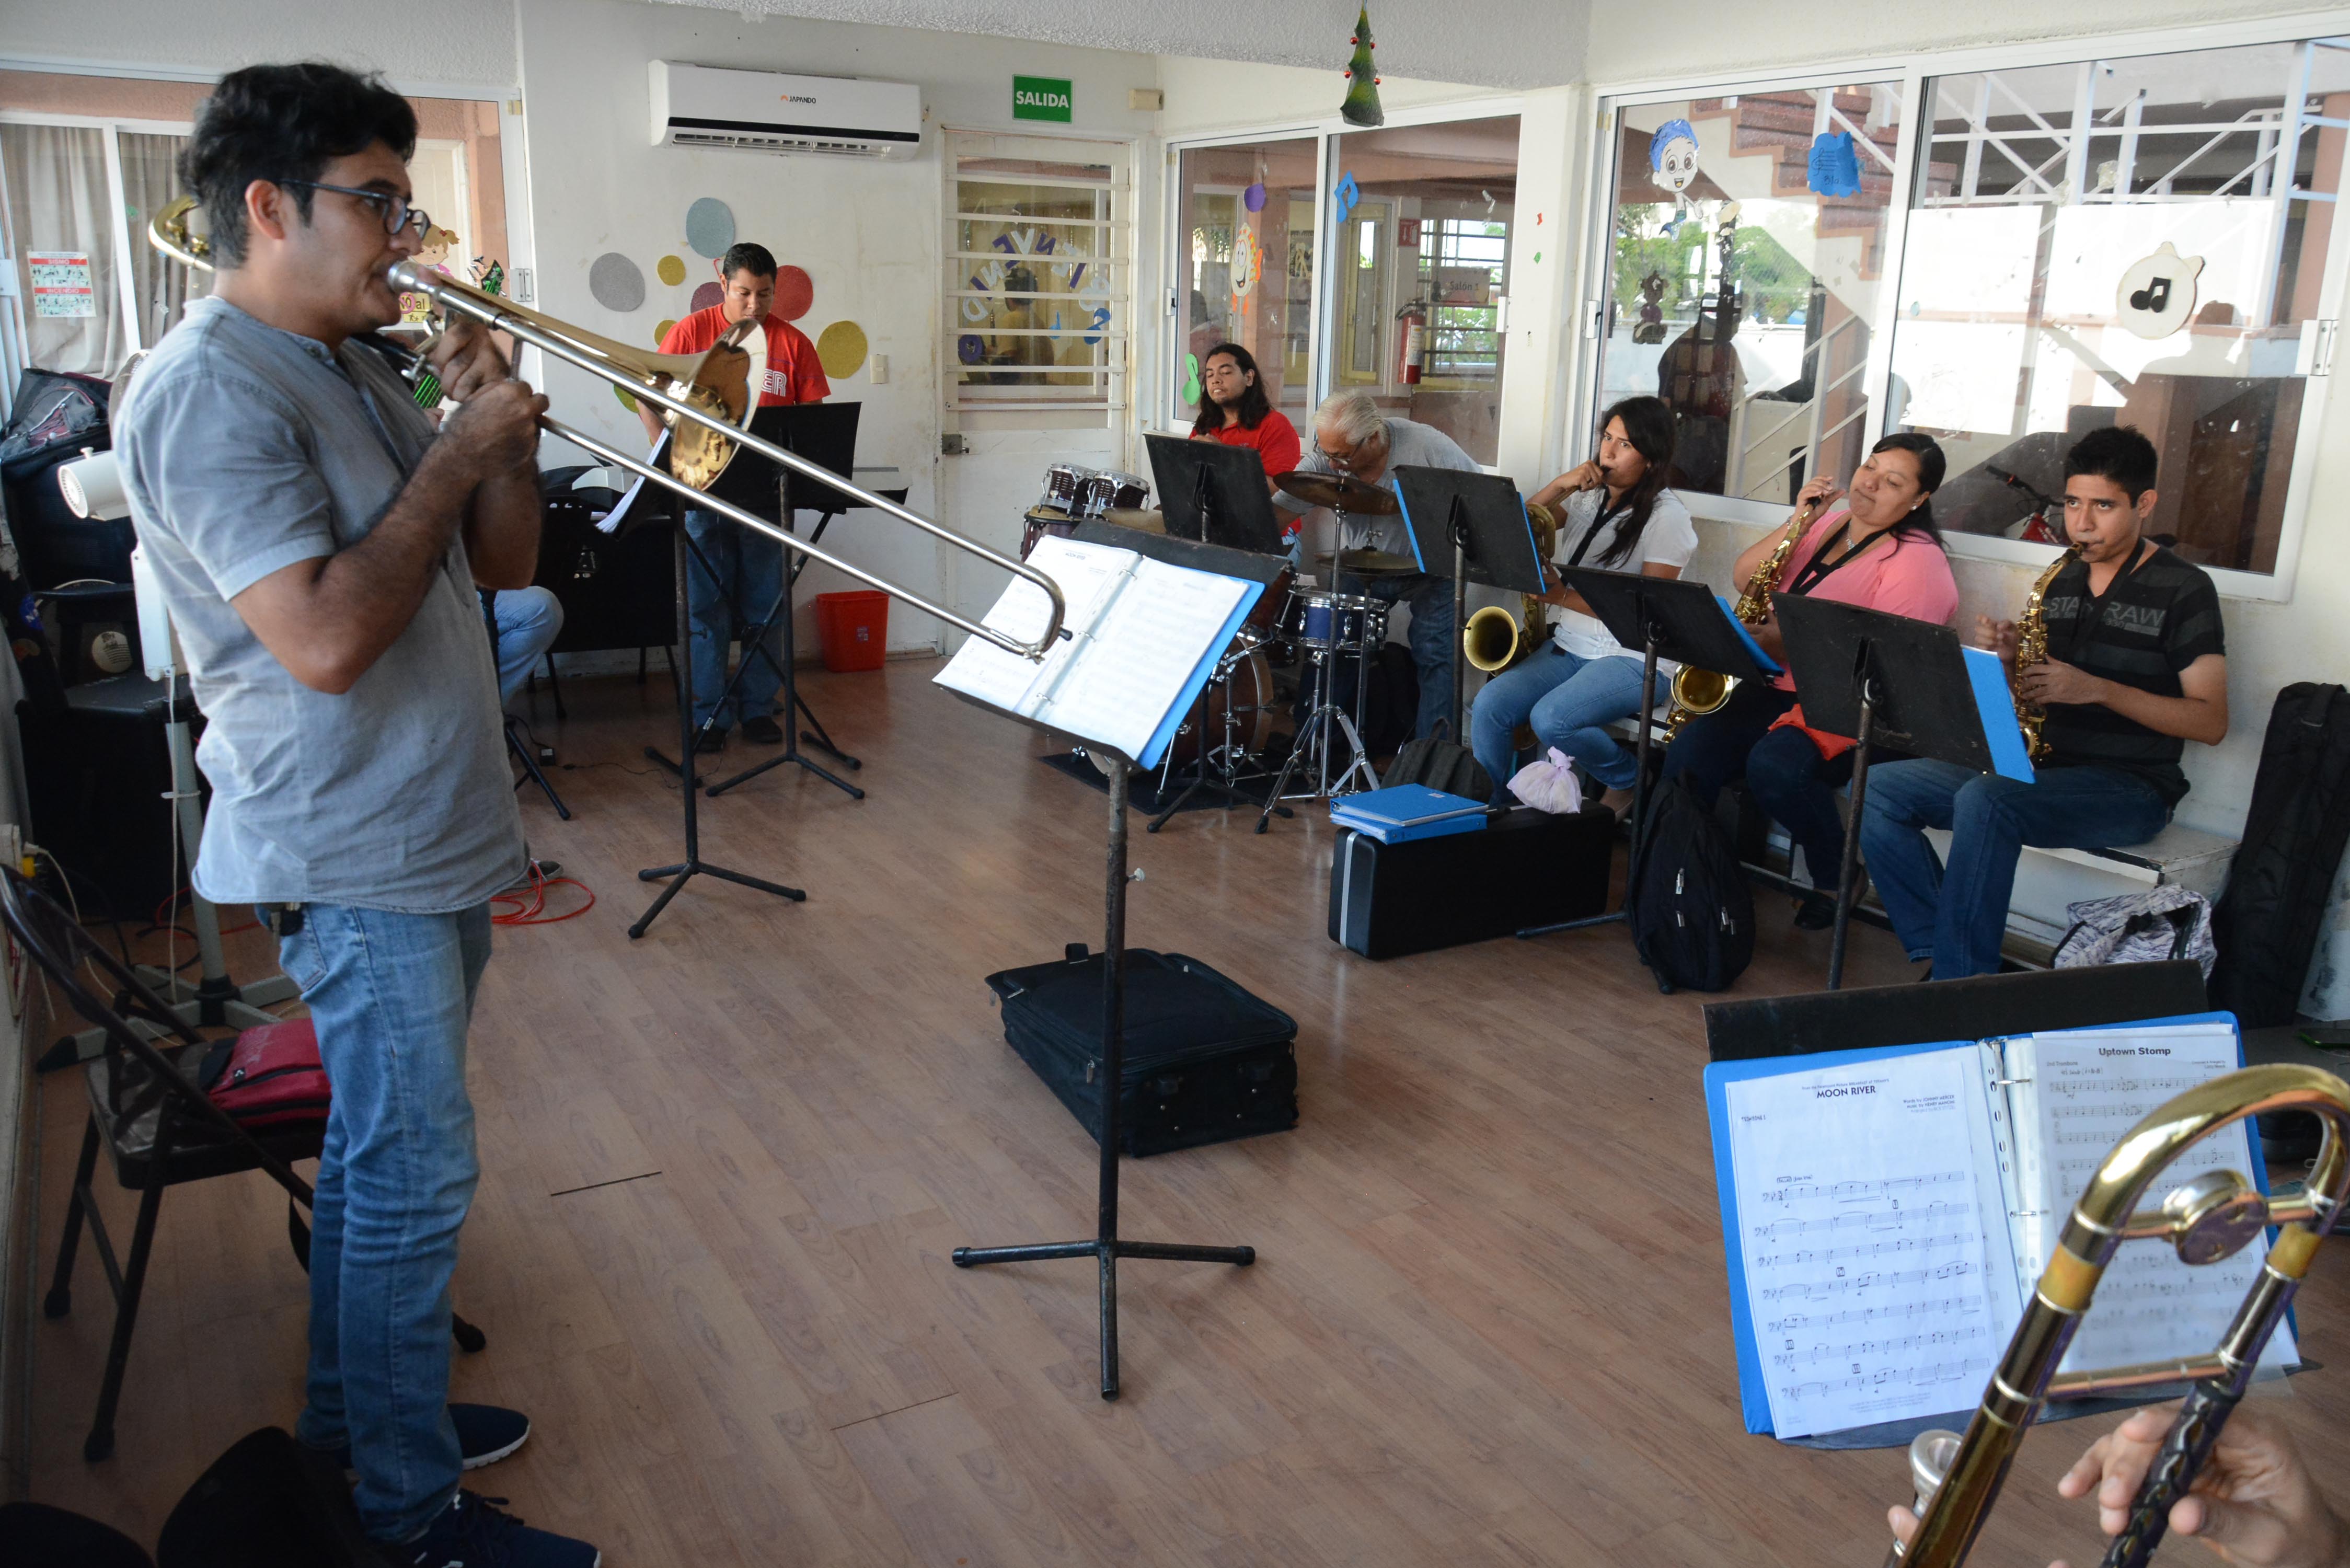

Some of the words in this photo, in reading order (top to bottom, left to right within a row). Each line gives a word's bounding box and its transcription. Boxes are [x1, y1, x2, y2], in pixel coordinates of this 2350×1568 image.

[1016, 91, 1069, 108] SALIDA
[1450, 281, 1473, 291] Salón
[2103, 601, 2166, 626] RAW
[2099, 1048, 2135, 1057] Uptown
[2138, 1047, 2171, 1056] Stomp
[1817, 1088, 1848, 1099] MOON
[1851, 1085, 1876, 1096] RIVER
